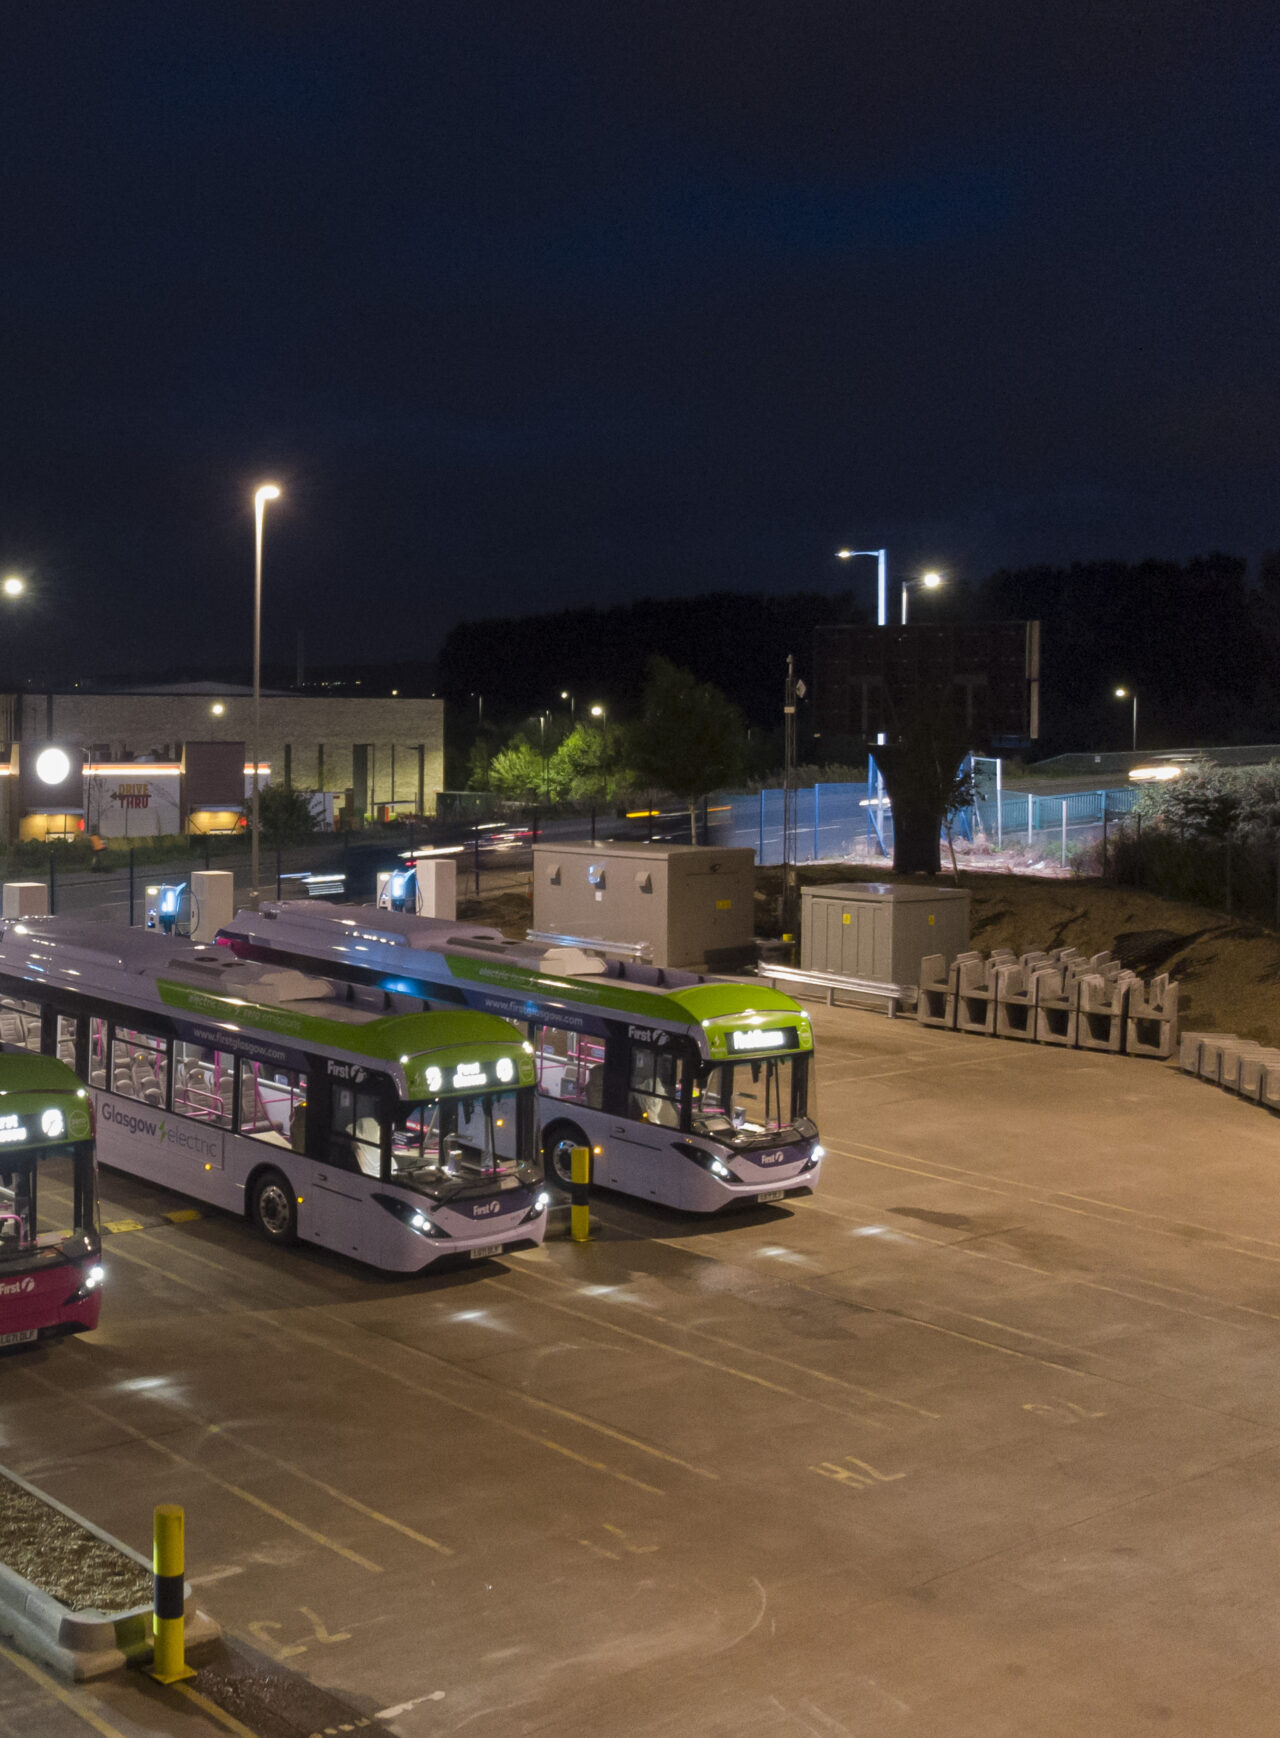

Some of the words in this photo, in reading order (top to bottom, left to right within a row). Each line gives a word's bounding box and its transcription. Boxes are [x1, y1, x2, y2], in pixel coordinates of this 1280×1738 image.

[118, 784, 149, 796] DRIVE
[120, 795, 149, 809] THRU
[628, 1025, 652, 1043] First
[194, 1028, 288, 1061] www.firstglasgow.com
[327, 1060, 350, 1079] First
[101, 1103, 157, 1136] Glasgow
[167, 1125, 217, 1158] electric
[473, 1204, 490, 1216] First
